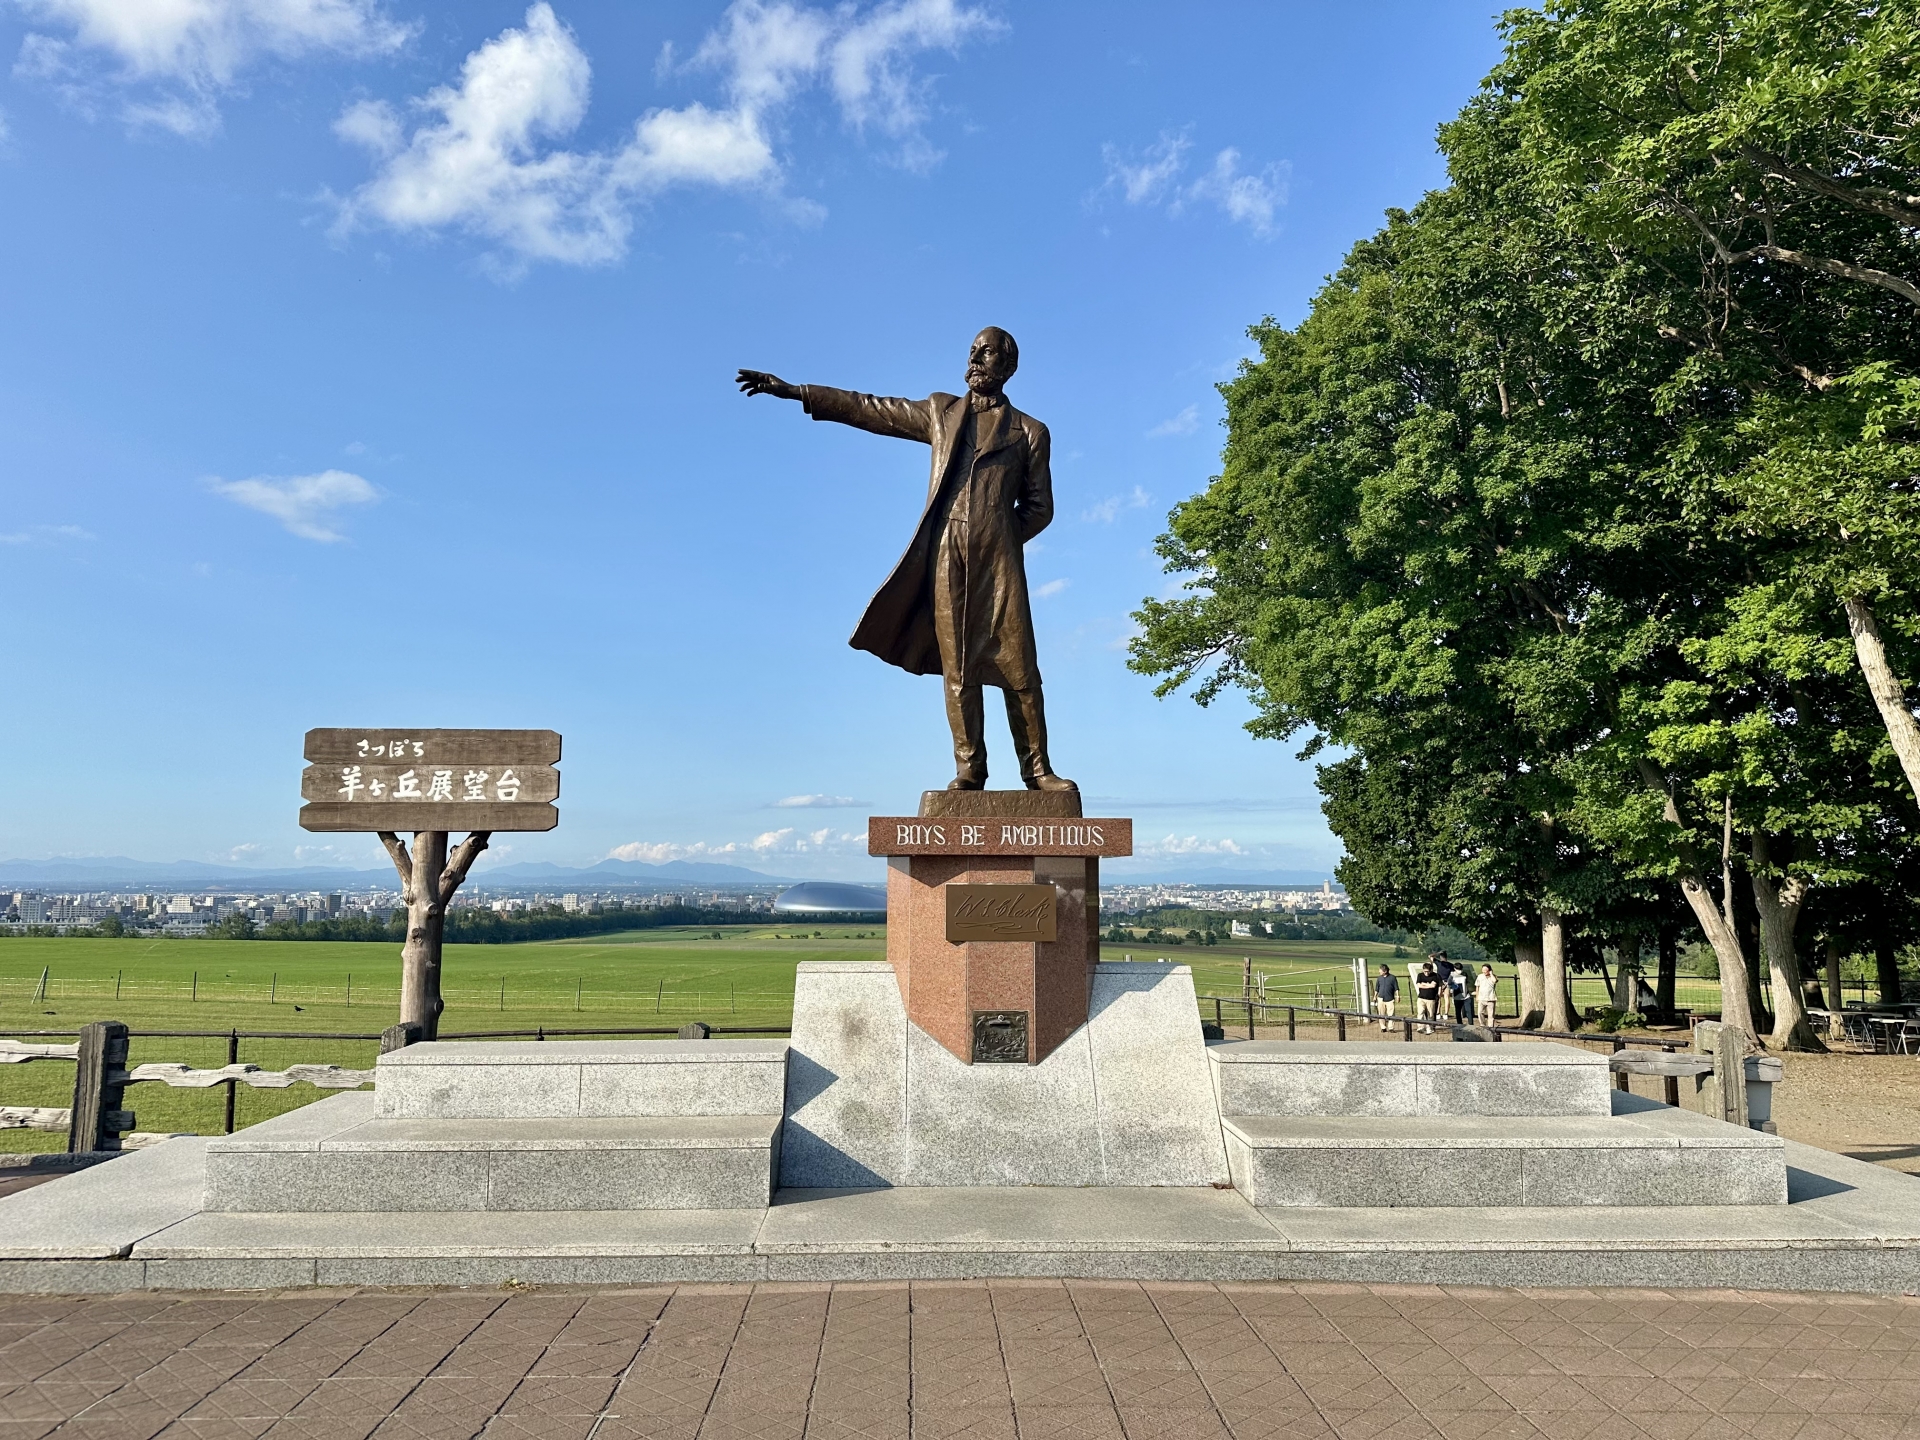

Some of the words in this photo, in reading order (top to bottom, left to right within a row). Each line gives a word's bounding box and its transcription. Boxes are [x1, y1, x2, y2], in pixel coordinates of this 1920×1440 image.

[356, 738, 425, 758] さっぽろ
[961, 825, 986, 846] BE
[1000, 825, 1105, 846] AMBITIOUS
